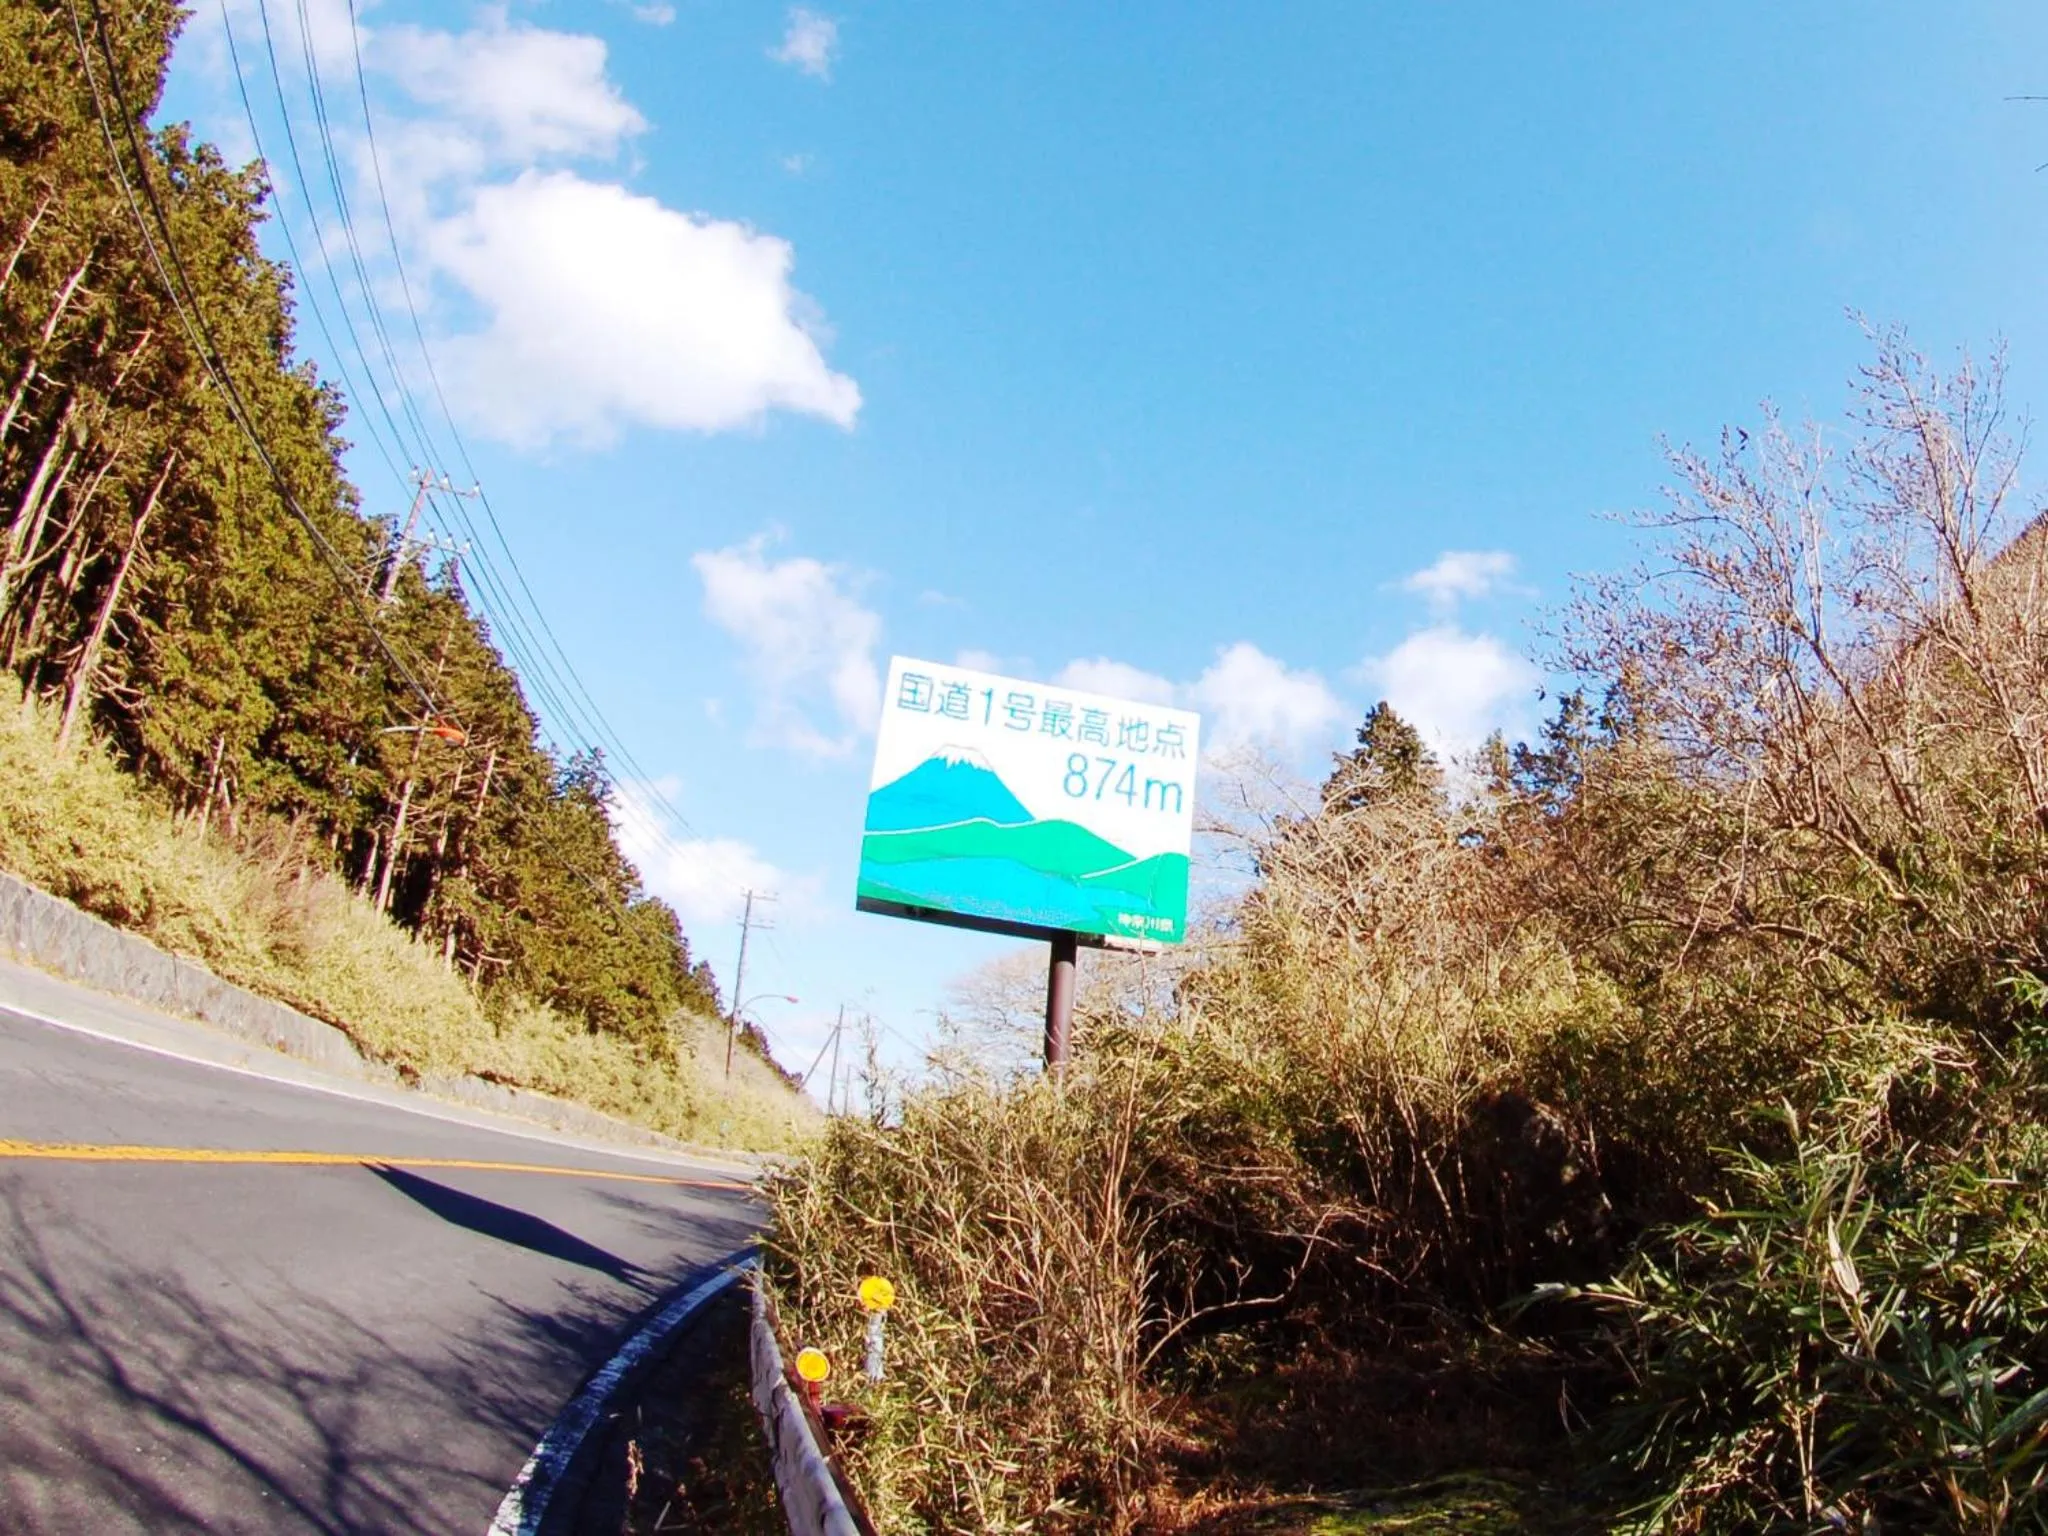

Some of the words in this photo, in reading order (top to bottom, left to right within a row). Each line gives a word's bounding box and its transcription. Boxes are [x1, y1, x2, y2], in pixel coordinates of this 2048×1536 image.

[898, 672, 1187, 759] 国道1号最高地点
[1063, 753, 1183, 813] 874m
